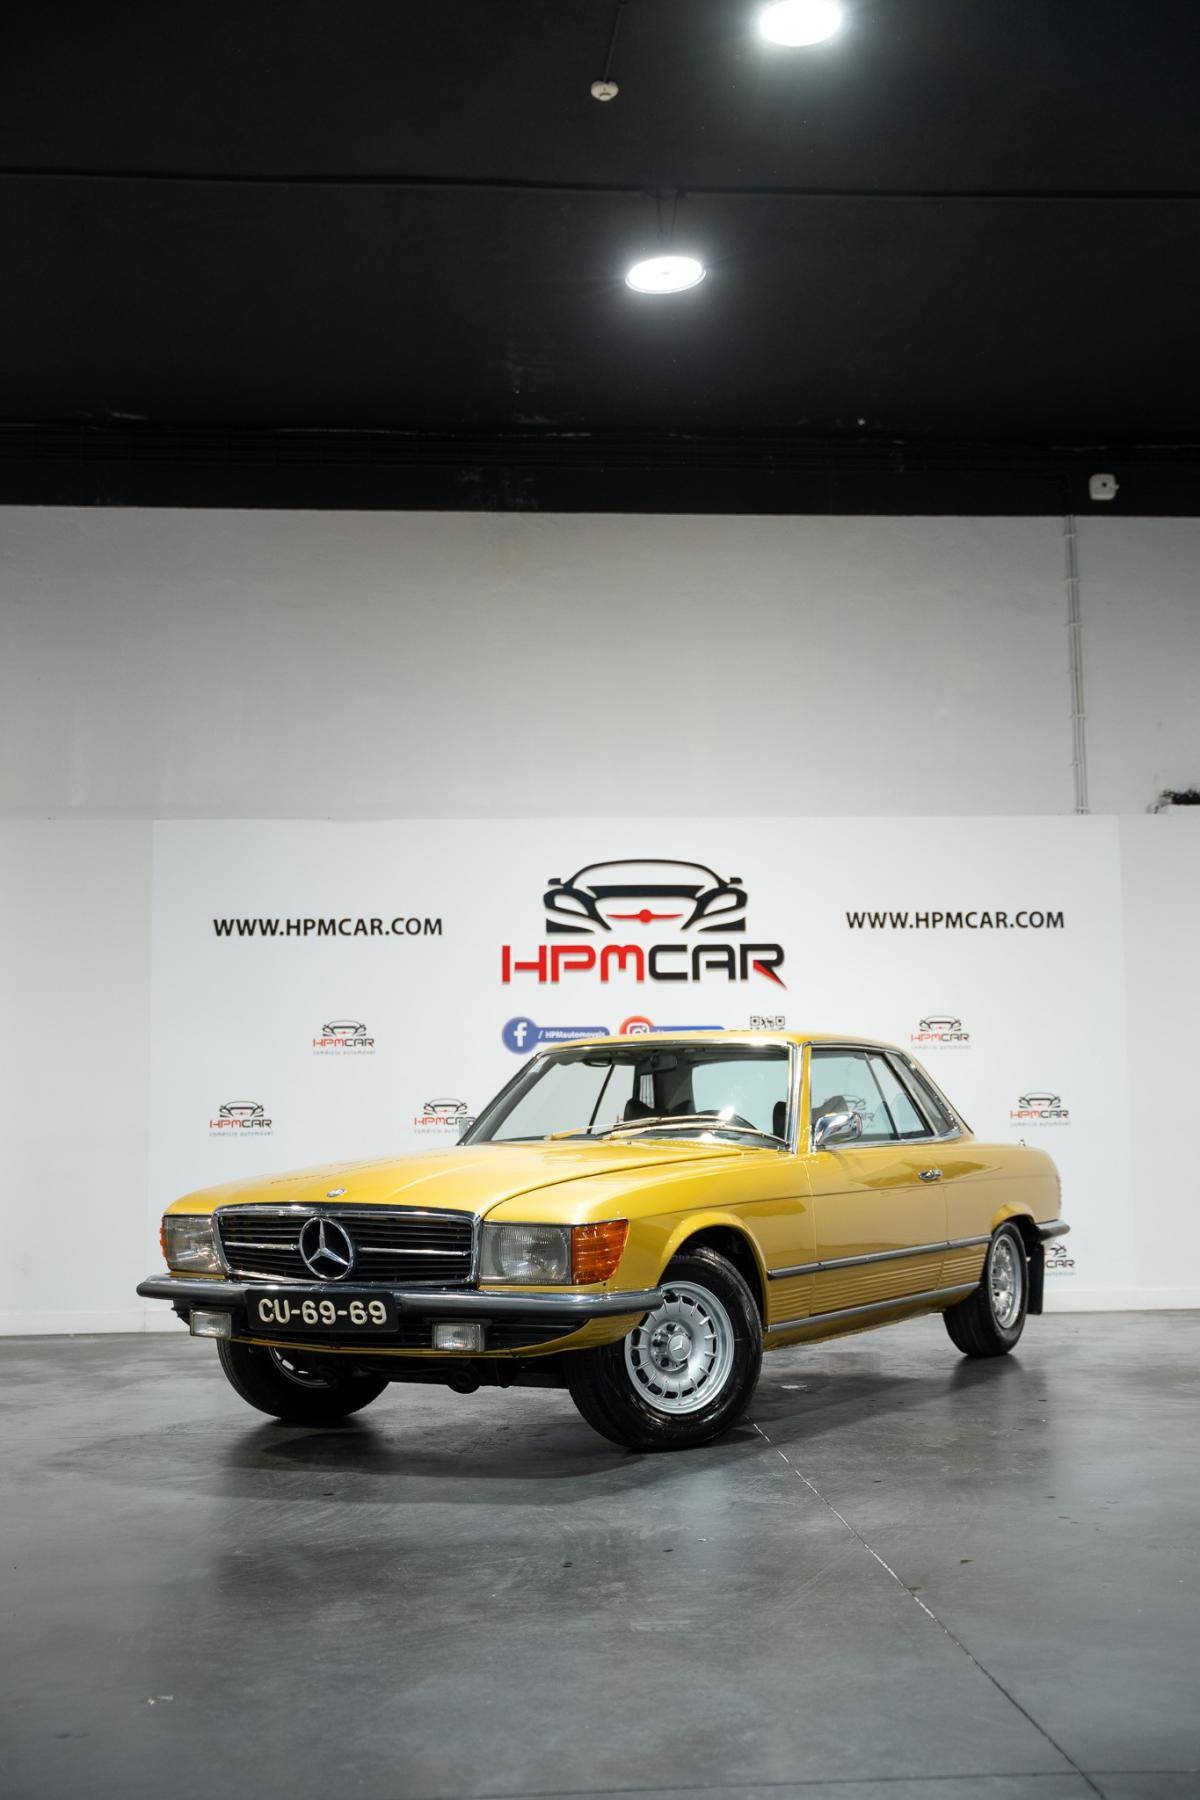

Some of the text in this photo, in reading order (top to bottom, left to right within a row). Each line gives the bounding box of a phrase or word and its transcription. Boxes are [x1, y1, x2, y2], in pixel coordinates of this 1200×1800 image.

[846, 911, 1065, 929] WWW.HPMCAR.COM
[213, 917, 443, 937] WWW.HPMCAR.COM
[501, 943, 788, 990] HPMCAR
[911, 1033, 970, 1042] HPMCAR
[313, 1038, 375, 1048] HPMCAR
[1010, 1110, 1070, 1119] HPMCAR
[209, 1119, 273, 1129] HPMCAR
[1046, 1259, 1075, 1269] CAR
[258, 1298, 388, 1325] CU-69-69
